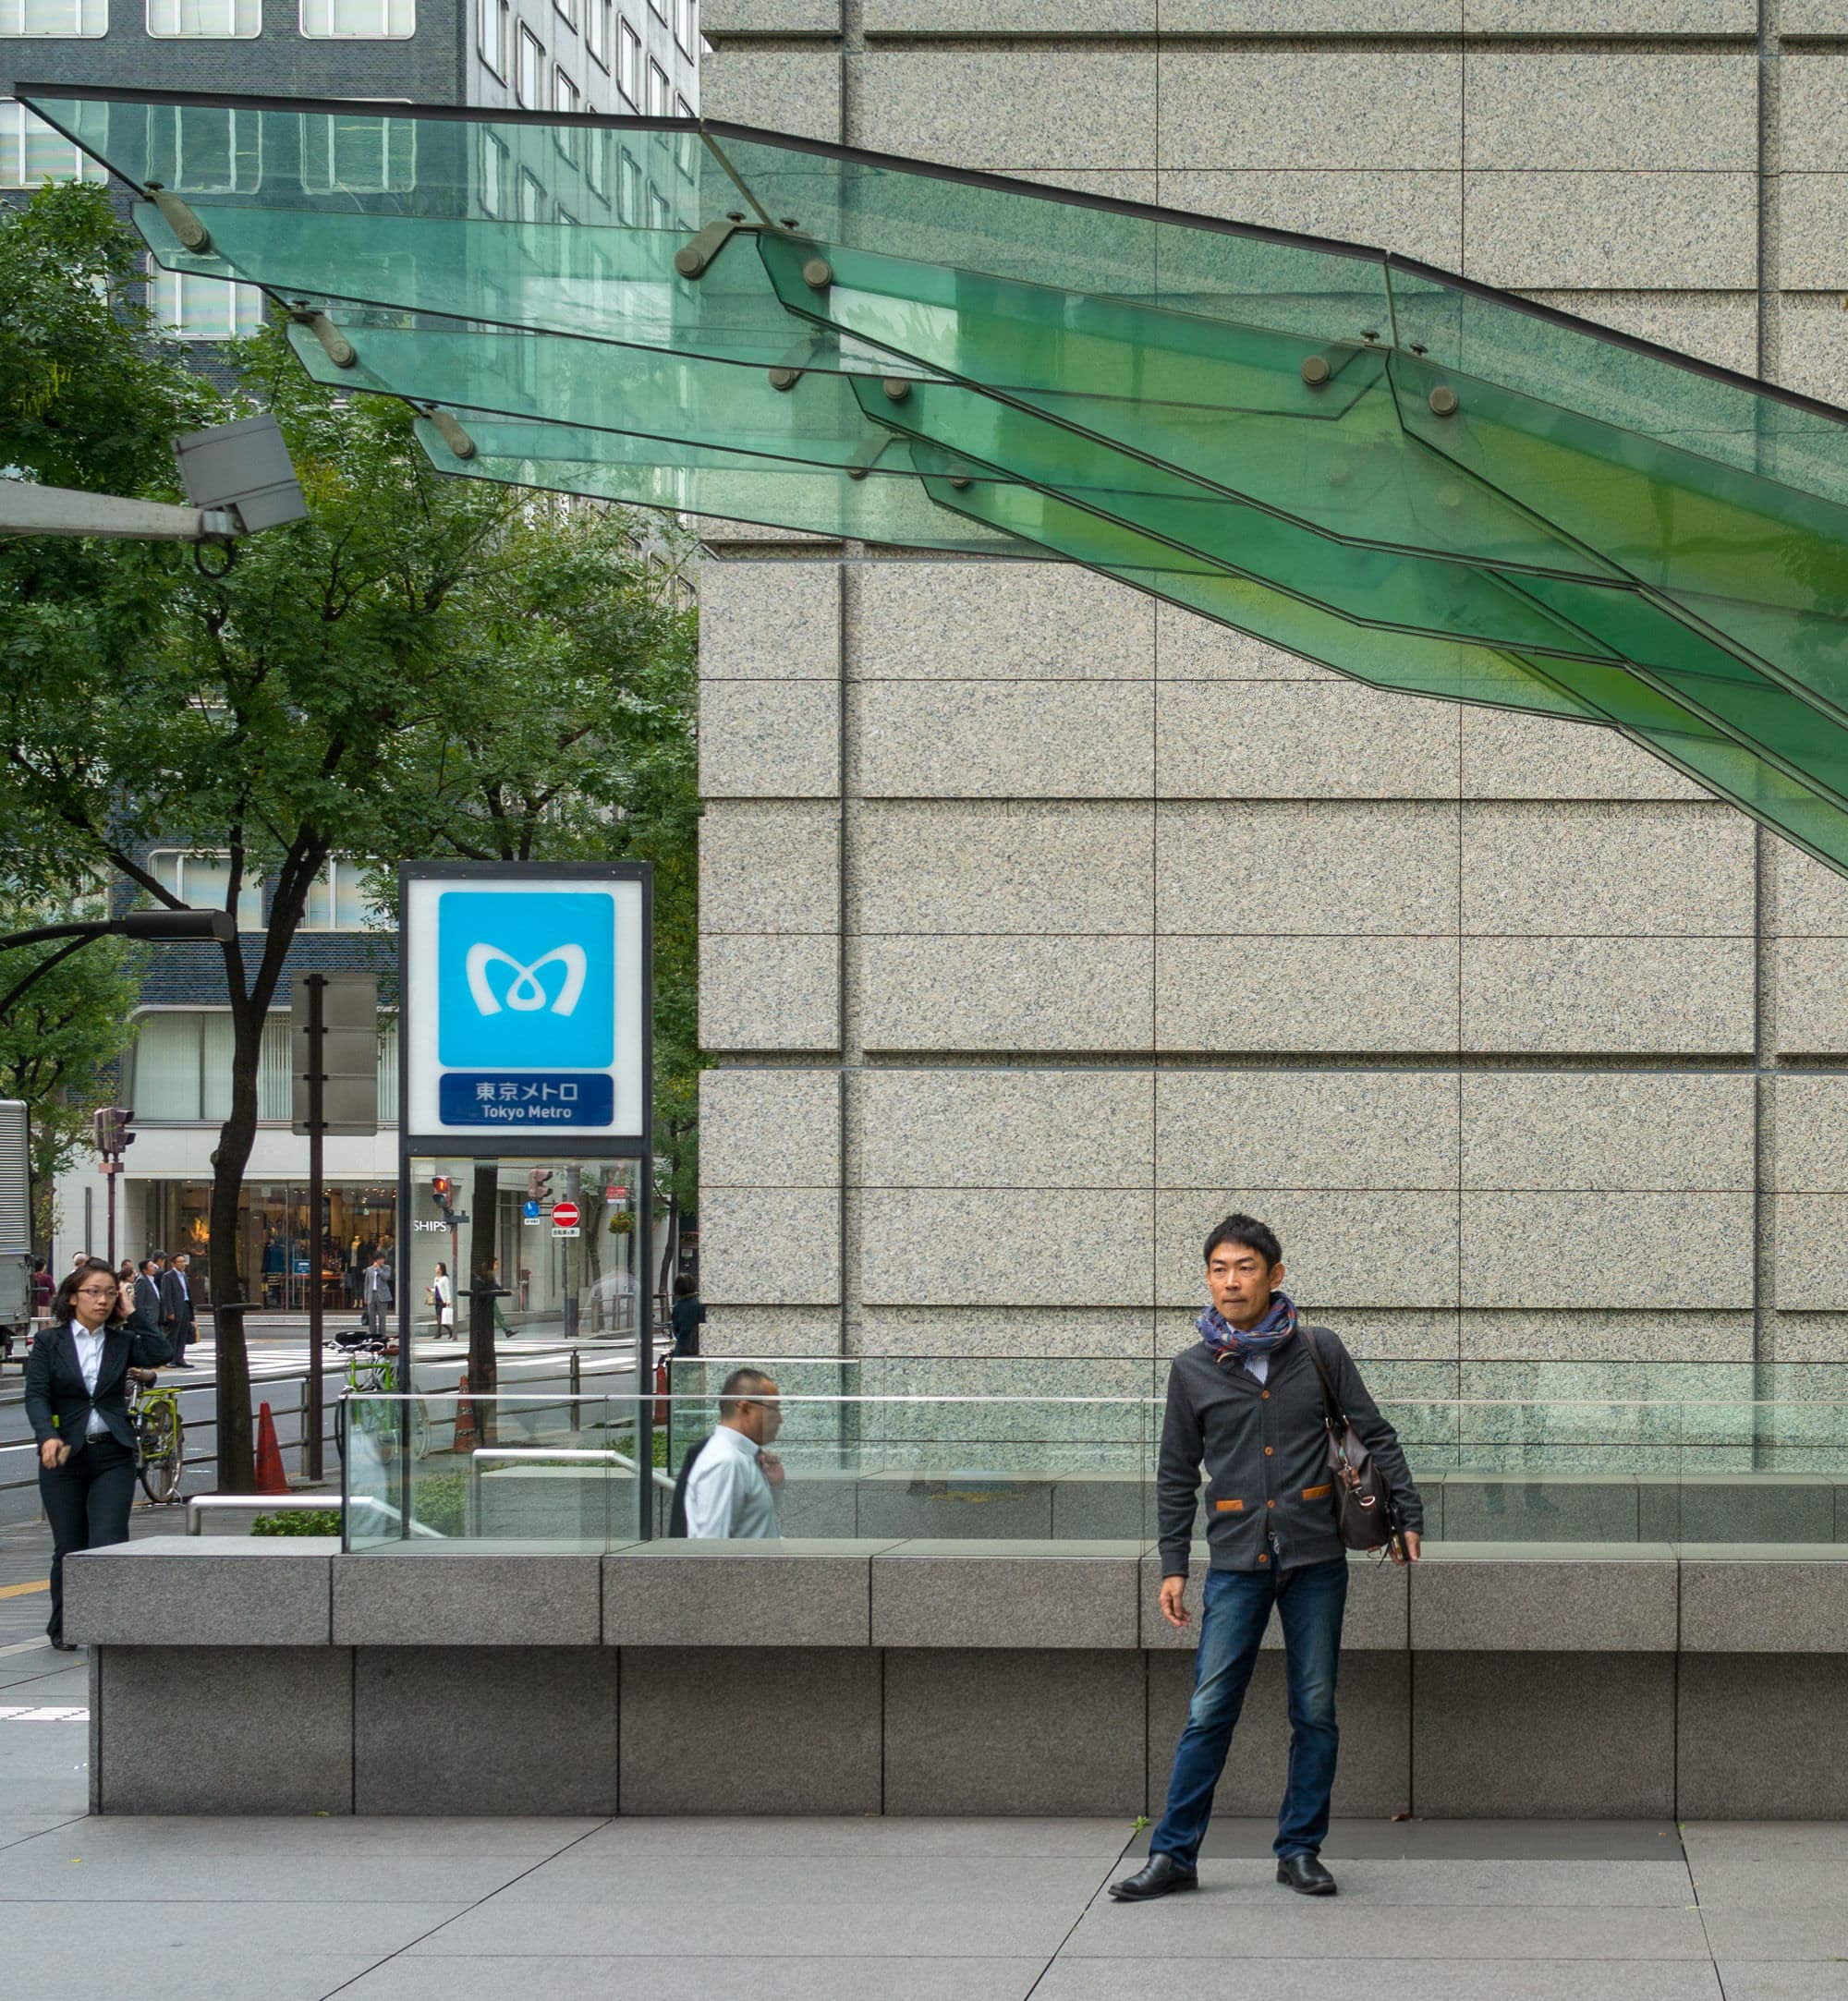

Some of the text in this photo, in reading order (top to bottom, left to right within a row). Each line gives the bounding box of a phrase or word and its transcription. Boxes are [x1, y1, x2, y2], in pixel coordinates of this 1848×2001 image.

[475, 1082, 578, 1101] 東京メトロ
[481, 1105, 572, 1122] Tokyo Metro
[413, 1219, 447, 1232] SHIPS
